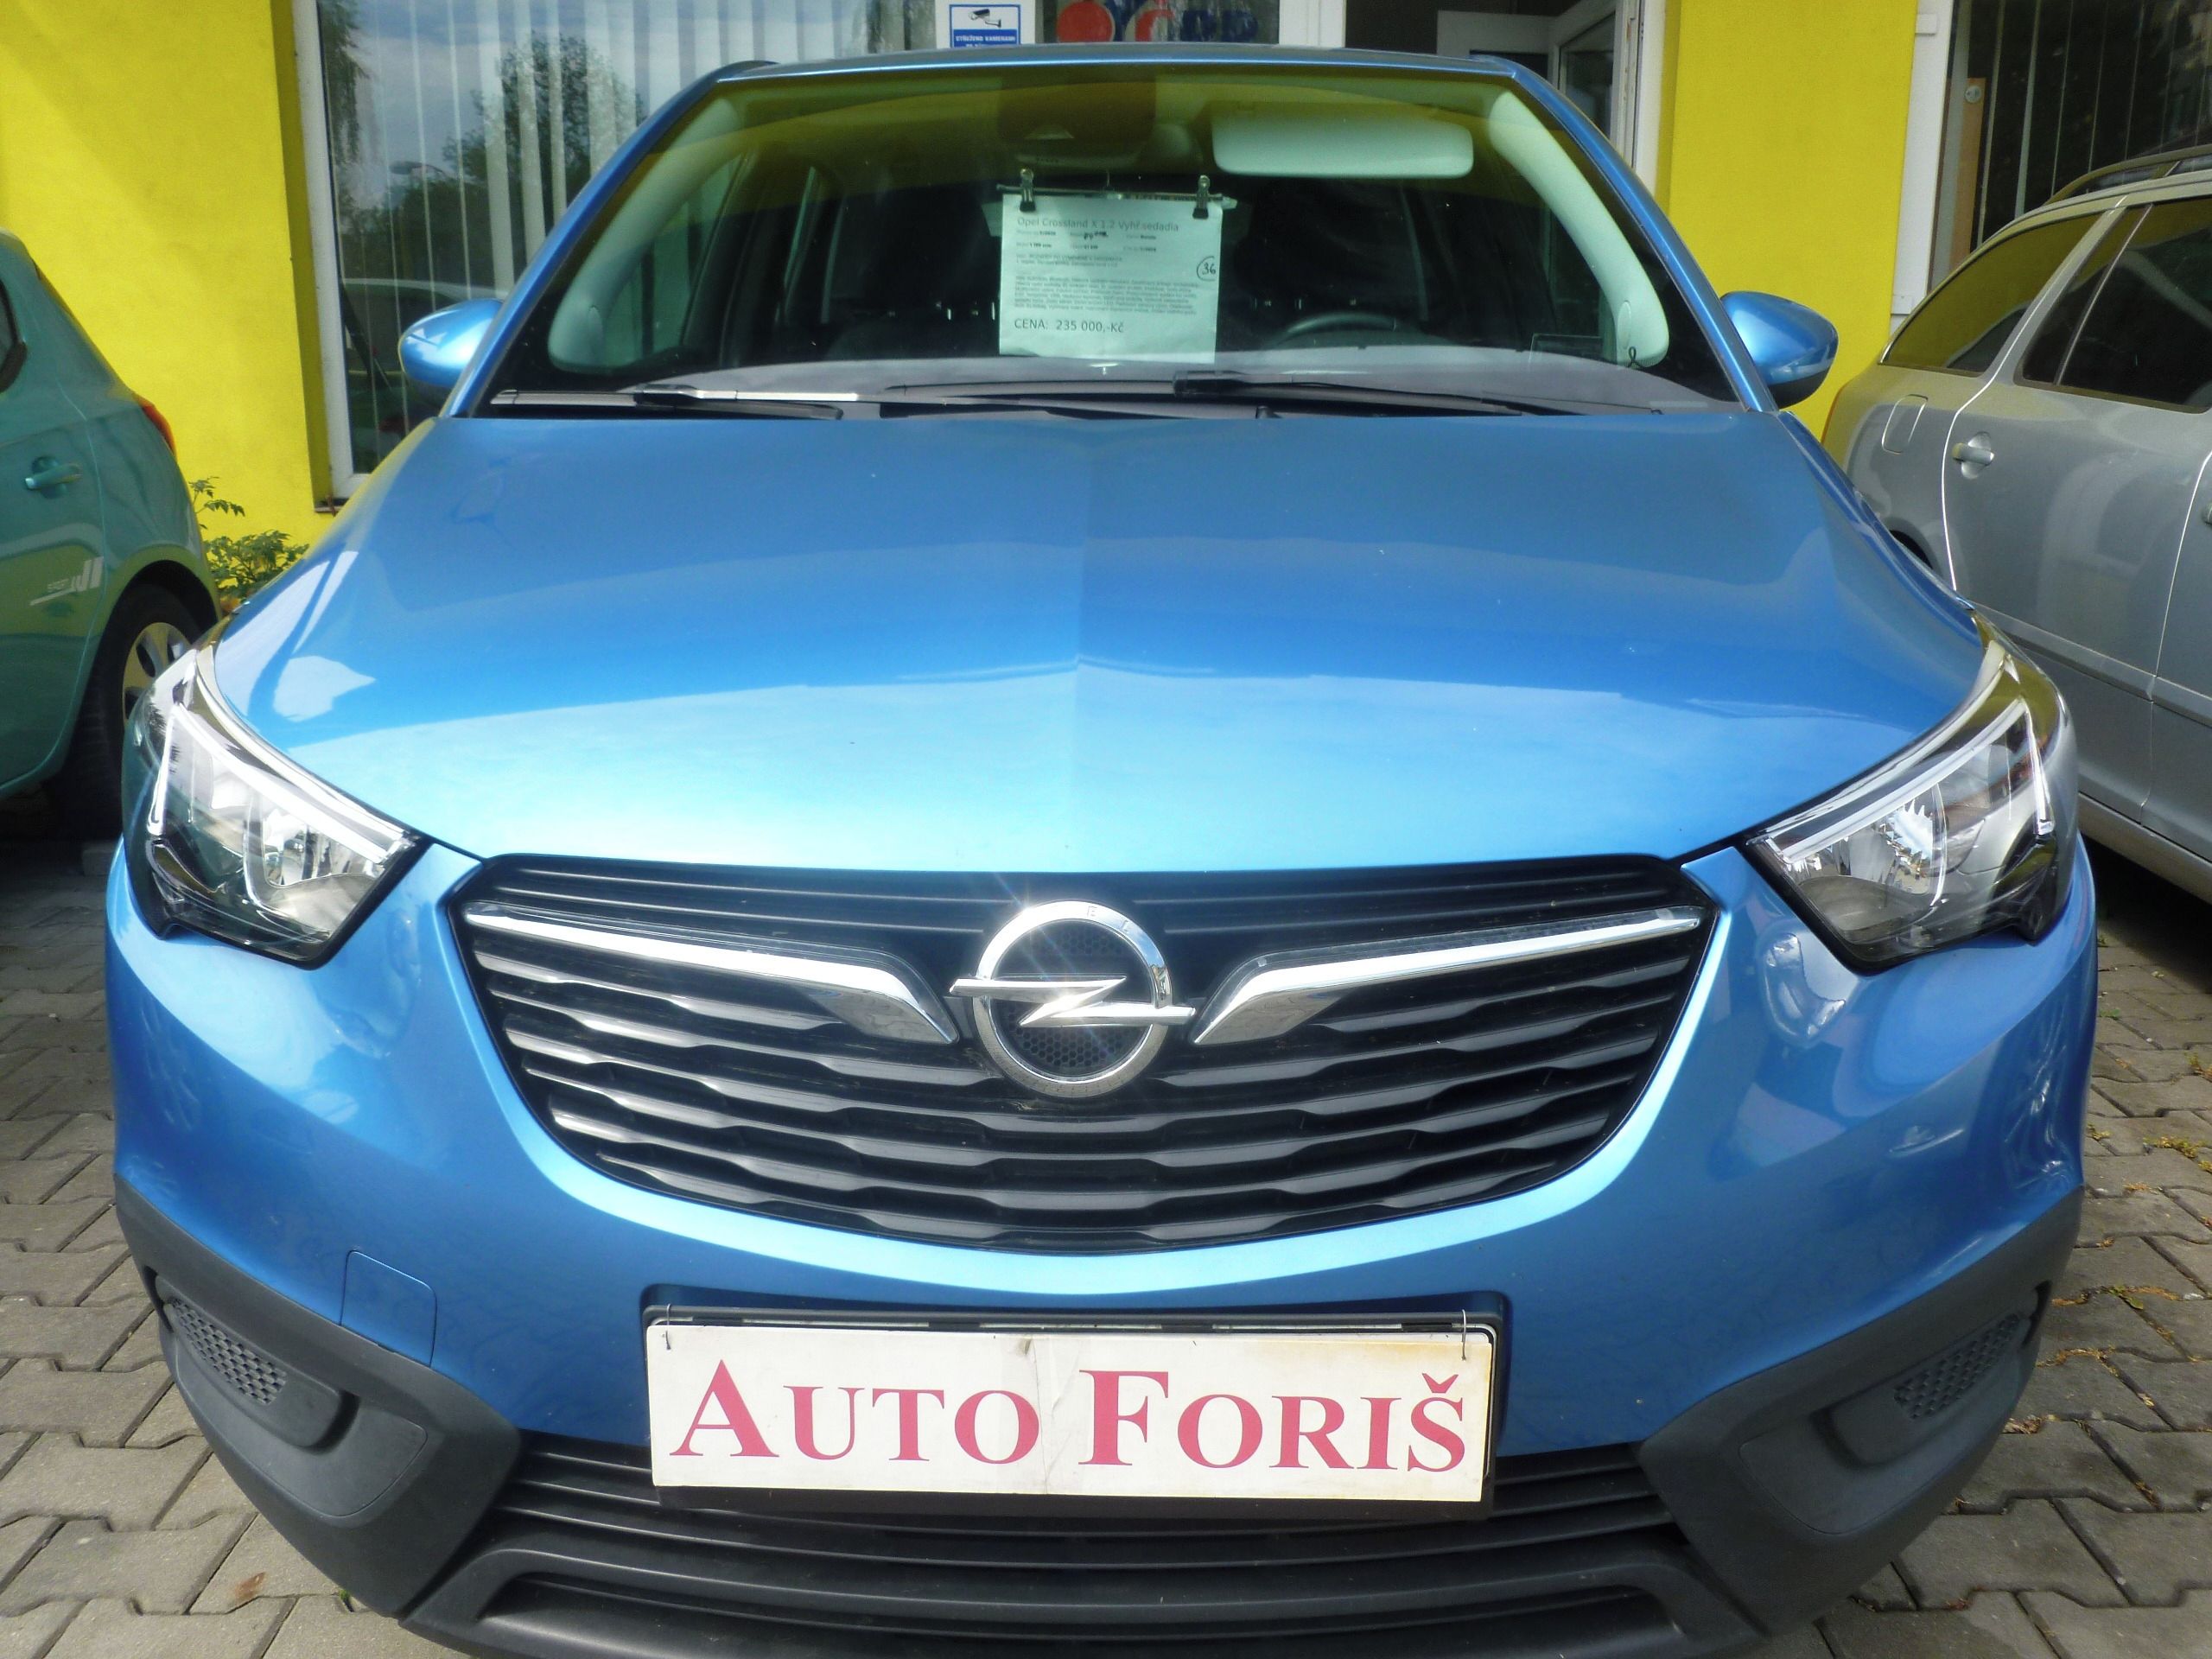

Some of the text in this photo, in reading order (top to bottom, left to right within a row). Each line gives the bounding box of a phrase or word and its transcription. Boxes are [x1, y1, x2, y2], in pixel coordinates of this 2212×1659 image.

[1017, 218, 1039, 226] Opel
[1042, 219, 1088, 229] Crossland
[1202, 262, 1216, 276] 36
[1014, 318, 1048, 330] CENA:
[1055, 320, 1077, 331] 235
[670, 1359, 1466, 1472] AUTO FORIŠ
